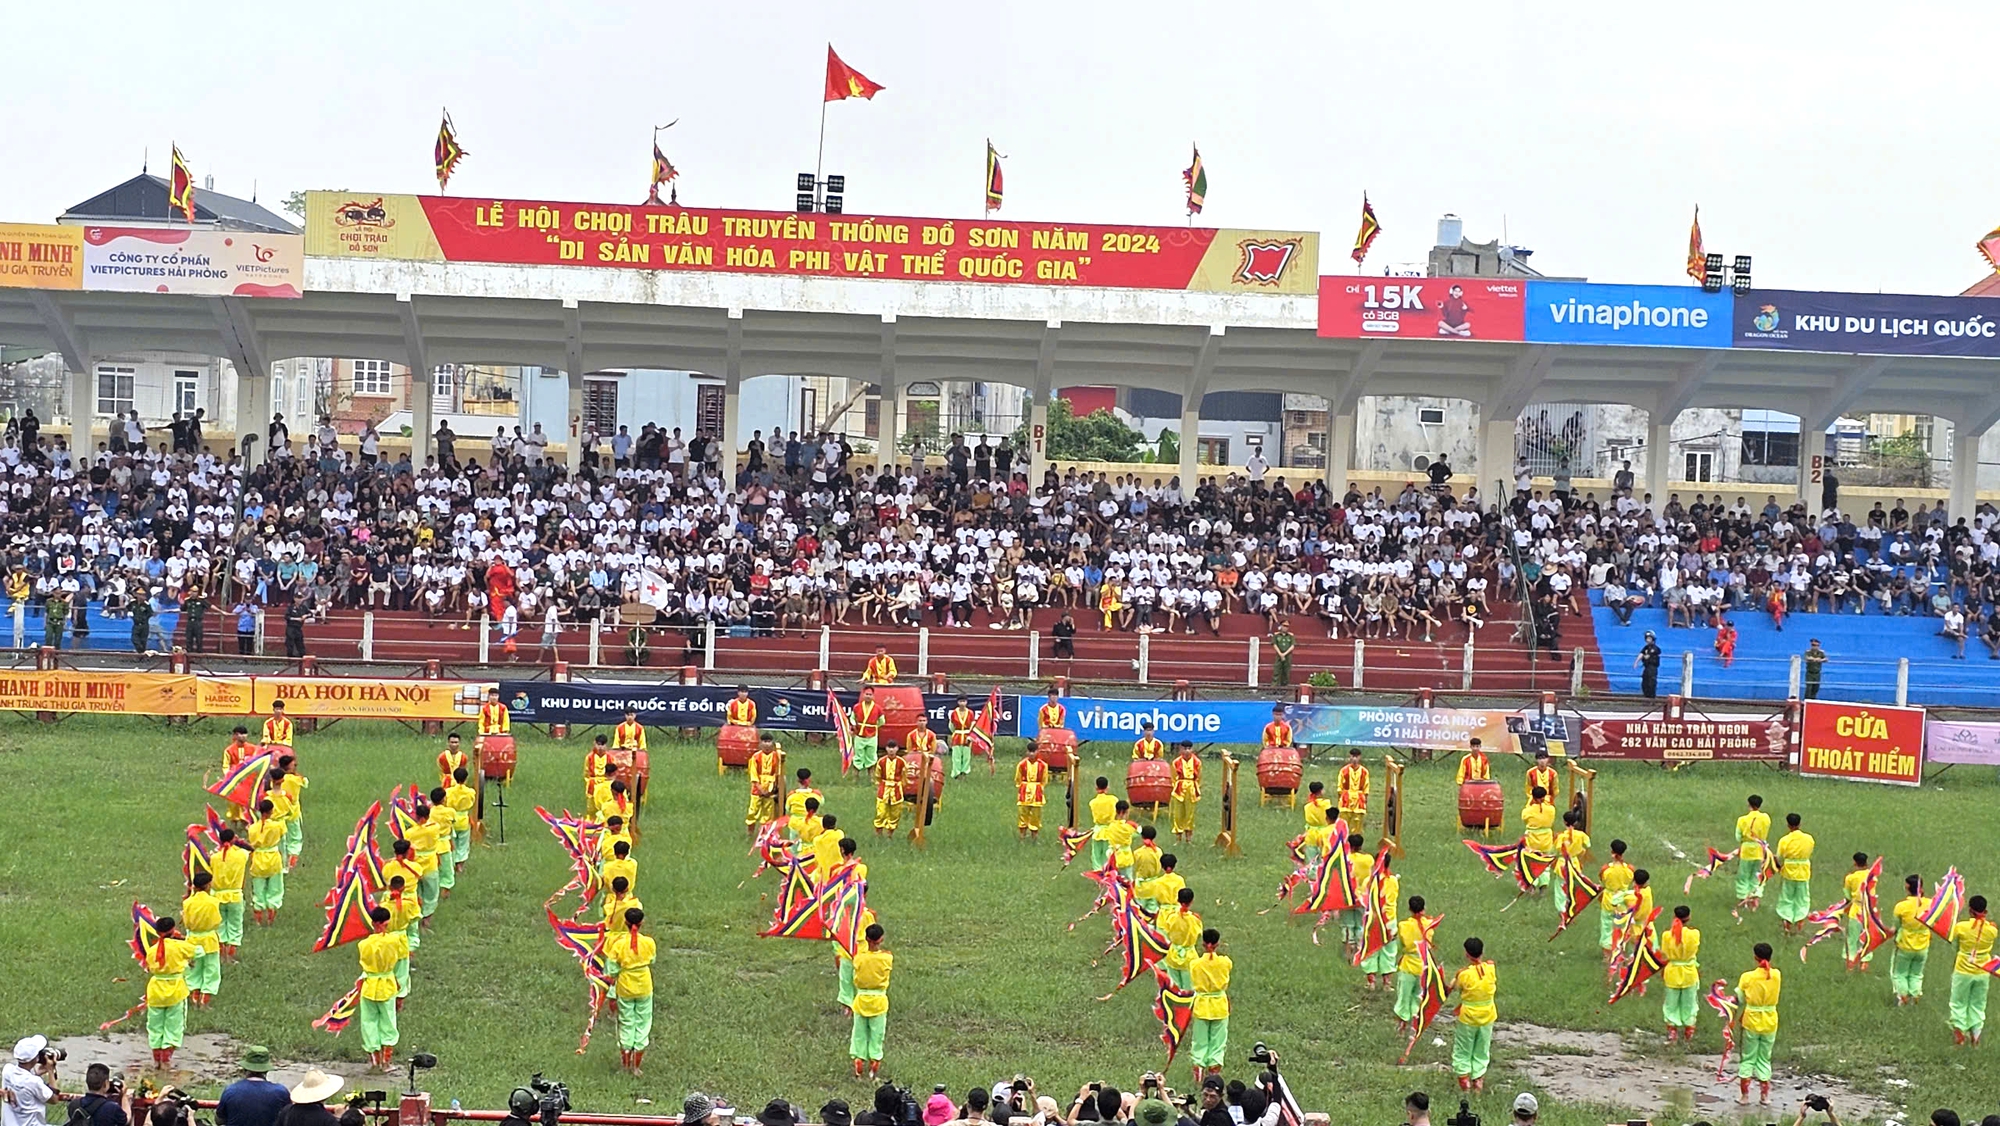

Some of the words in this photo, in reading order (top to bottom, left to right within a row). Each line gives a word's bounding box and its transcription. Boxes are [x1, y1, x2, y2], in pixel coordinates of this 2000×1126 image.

[476, 201, 504, 227] LỄ
[518, 205, 560, 233] HỘI
[574, 211, 632, 236] CHỌI
[645, 211, 709, 236] TRÂU
[722, 214, 816, 240] TRUYỀN
[829, 217, 909, 244] THỐNG
[922, 220, 955, 246] ĐỒ
[968, 227, 1019, 248] SƠN
[1032, 227, 1089, 250] NĂM
[1102, 233, 1161, 254] 2024
[28, 243, 73, 264] MINH
[109, 252, 143, 264] CÔNG
[146, 255, 159, 264] TY
[162, 252, 178, 264] CỔ
[598, 237, 650, 263] SẢN
[663, 241, 712, 265] VĂN
[726, 244, 775, 268] HÓA
[789, 250, 830, 270] PHI
[844, 249, 888, 276] VẬT
[901, 248, 947, 275] THỂ
[958, 252, 1023, 278] QUỐC
[12, 264, 28, 275] GIA
[31, 264, 72, 277] TRUYỀN
[91, 264, 166, 276] VIETPICTURES
[168, 266, 186, 277] HẢI
[188, 267, 228, 278] PHÒNG
[236, 264, 290, 274] VIETPictures
[1486, 284, 1518, 292] viettel
[1364, 284, 1424, 310] 15K
[1377, 311, 1400, 320] 3GB
[1549, 298, 1708, 330] vinaphone
[1795, 315, 1840, 332] KHU
[1845, 317, 1875, 334] DU
[1880, 318, 1928, 338] LỊCH
[1933, 314, 1996, 338] QUỐC
[44, 677, 81, 698] BÌNH
[86, 682, 125, 700] MINH
[276, 684, 310, 699] BIA
[314, 685, 354, 700] HƠI
[360, 682, 391, 701] HÀ
[394, 684, 431, 706] NỘI
[17, 700, 48, 709] TRUNG
[51, 701, 69, 710] THU
[72, 702, 91, 710] GIA
[93, 700, 125, 711] TRUYỀN
[541, 698, 570, 708] KHU
[572, 698, 592, 708] DU
[594, 699, 624, 712] LỊCH
[628, 697, 666, 710] QUỐC
[669, 698, 688, 711] TẾ
[928, 706, 946, 720] TẾ
[1078, 706, 1221, 734] vinaphone
[1358, 710, 1404, 722] PHÒNG
[1406, 712, 1430, 724] TRÀ
[1432, 715, 1450, 725] CA
[1452, 716, 1487, 729] NHẠC
[1836, 710, 1889, 740] CỬA
[1374, 724, 1392, 737] SỐ
[1394, 728, 1399, 737] 1
[1402, 726, 1422, 739] HẢI
[1626, 722, 1648, 734] NHÀ
[1652, 722, 1682, 734] HÀNG
[1686, 722, 1714, 735] TRÂU
[1718, 724, 1749, 735] NGON
[1646, 735, 1667, 748] VĂN
[1672, 738, 1693, 748] CAO
[1697, 735, 1716, 748] HẢI
[1720, 736, 1756, 748] PHÒNG
[1807, 746, 1864, 772] THOÁT
[1868, 746, 1916, 776] HIỂM
